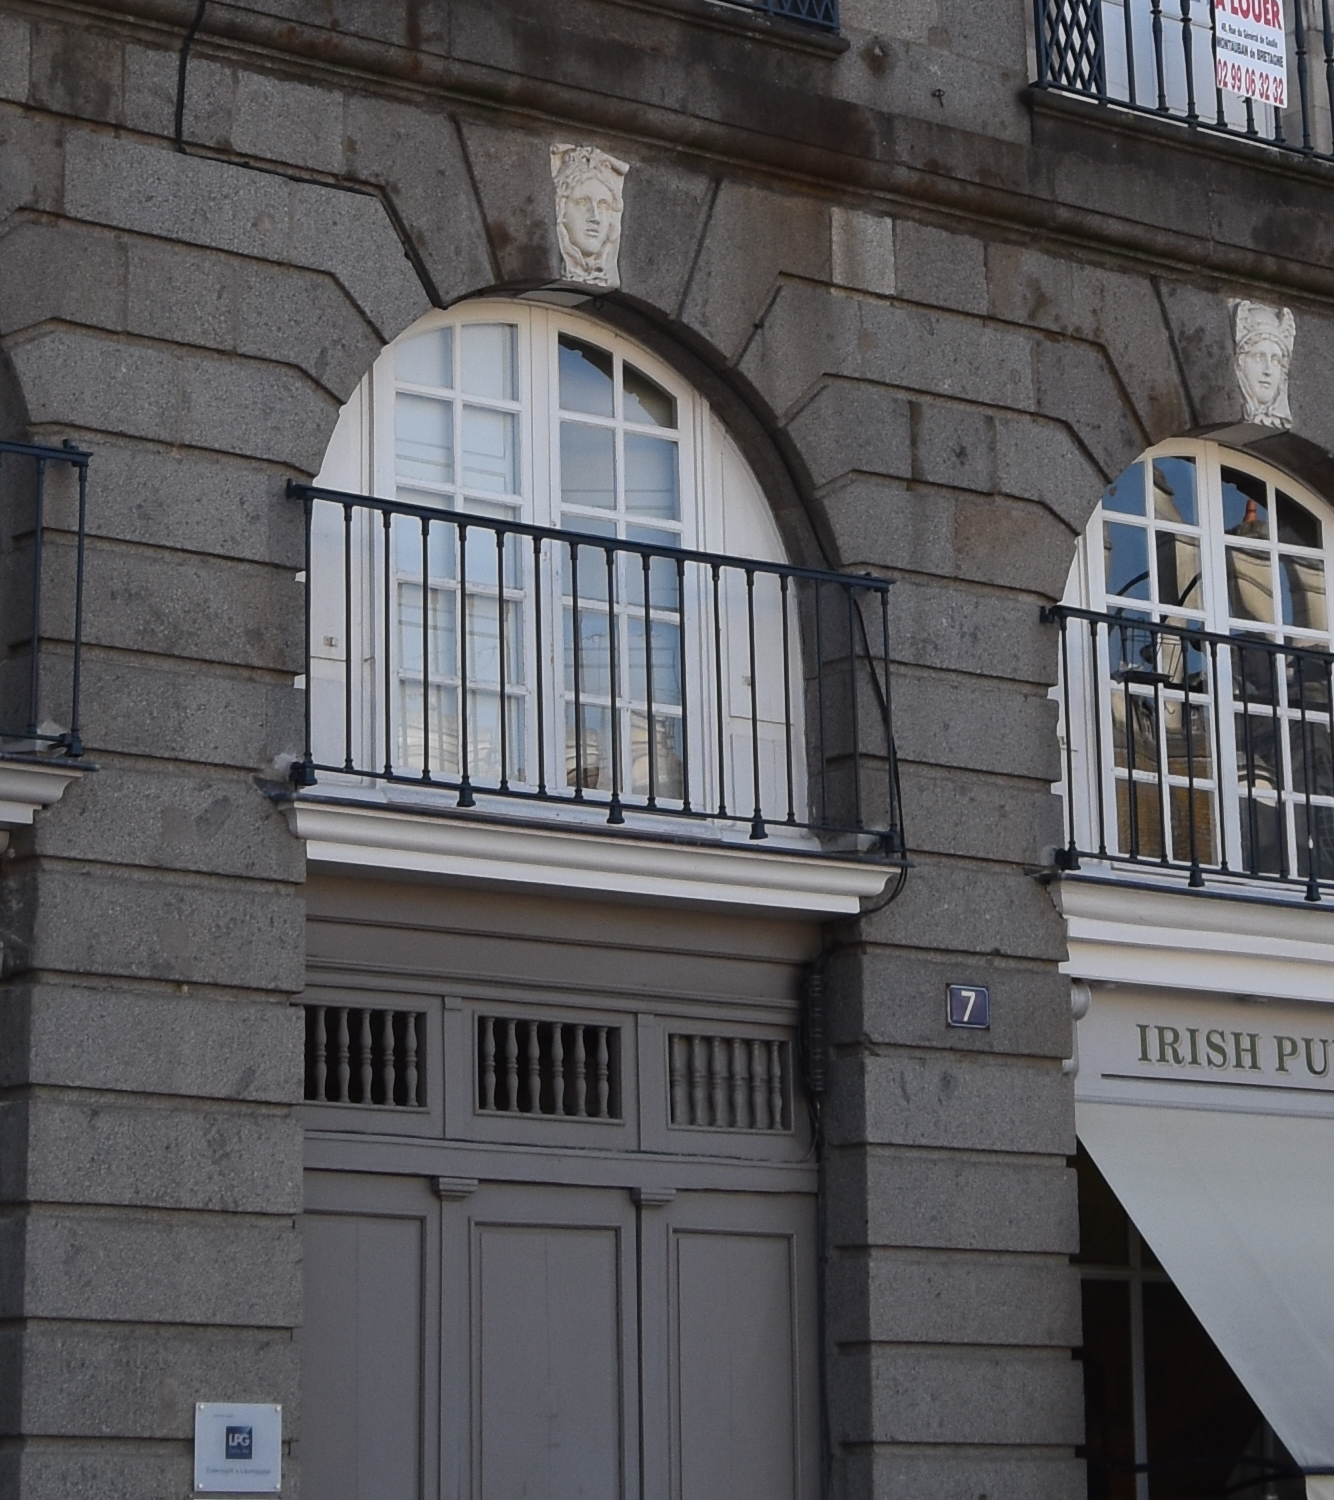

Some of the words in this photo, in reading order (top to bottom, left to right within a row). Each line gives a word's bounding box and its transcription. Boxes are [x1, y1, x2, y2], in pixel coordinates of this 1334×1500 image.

[1257, 48, 1284, 68] BRETAGNE
[1217, 58, 1228, 89] 02
[1231, 62, 1242, 93] 99
[1245, 66, 1256, 97] 06
[1259, 71, 1270, 101] 32
[1273, 75, 1284, 105] 32
[961, 990, 976, 1022] 7
[1136, 1023, 1262, 1072] IRISH
[228, 1433, 250, 1447] LPG
